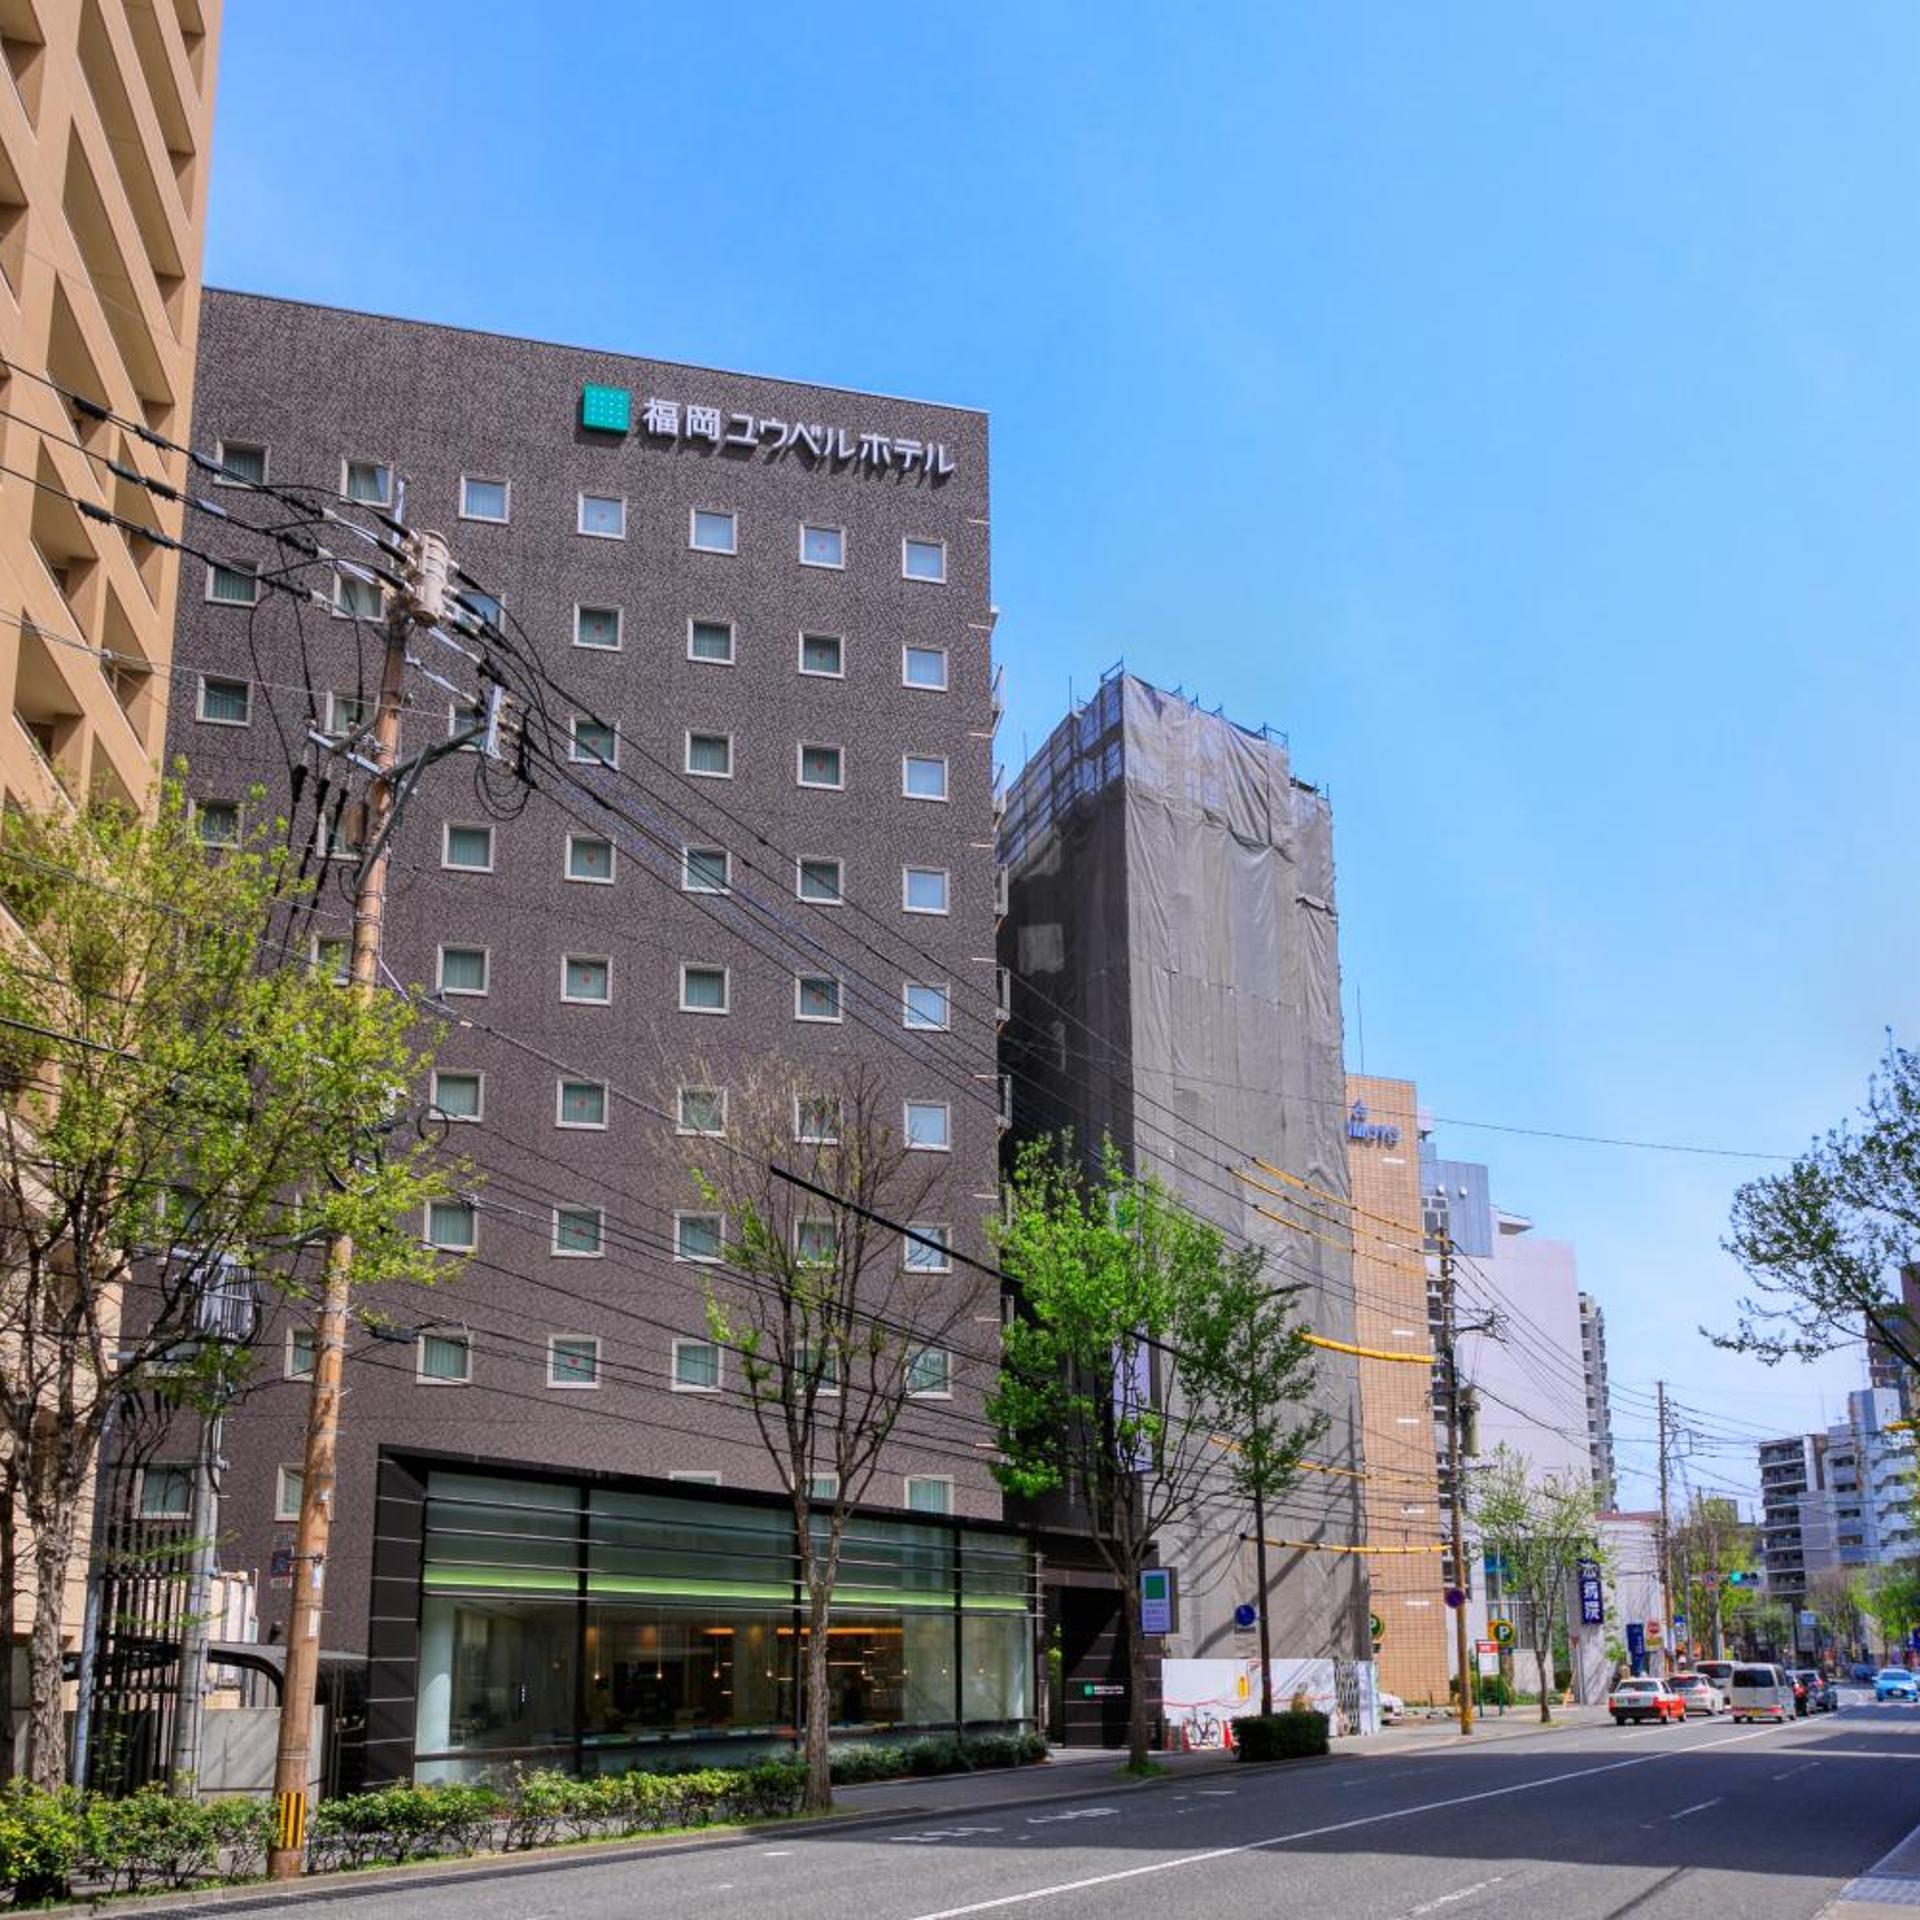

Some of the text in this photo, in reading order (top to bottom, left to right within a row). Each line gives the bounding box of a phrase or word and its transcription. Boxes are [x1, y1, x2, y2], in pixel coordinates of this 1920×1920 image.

[643, 397, 956, 473] 福岡ユウベルホテル
[1498, 1625, 1511, 1641] P
